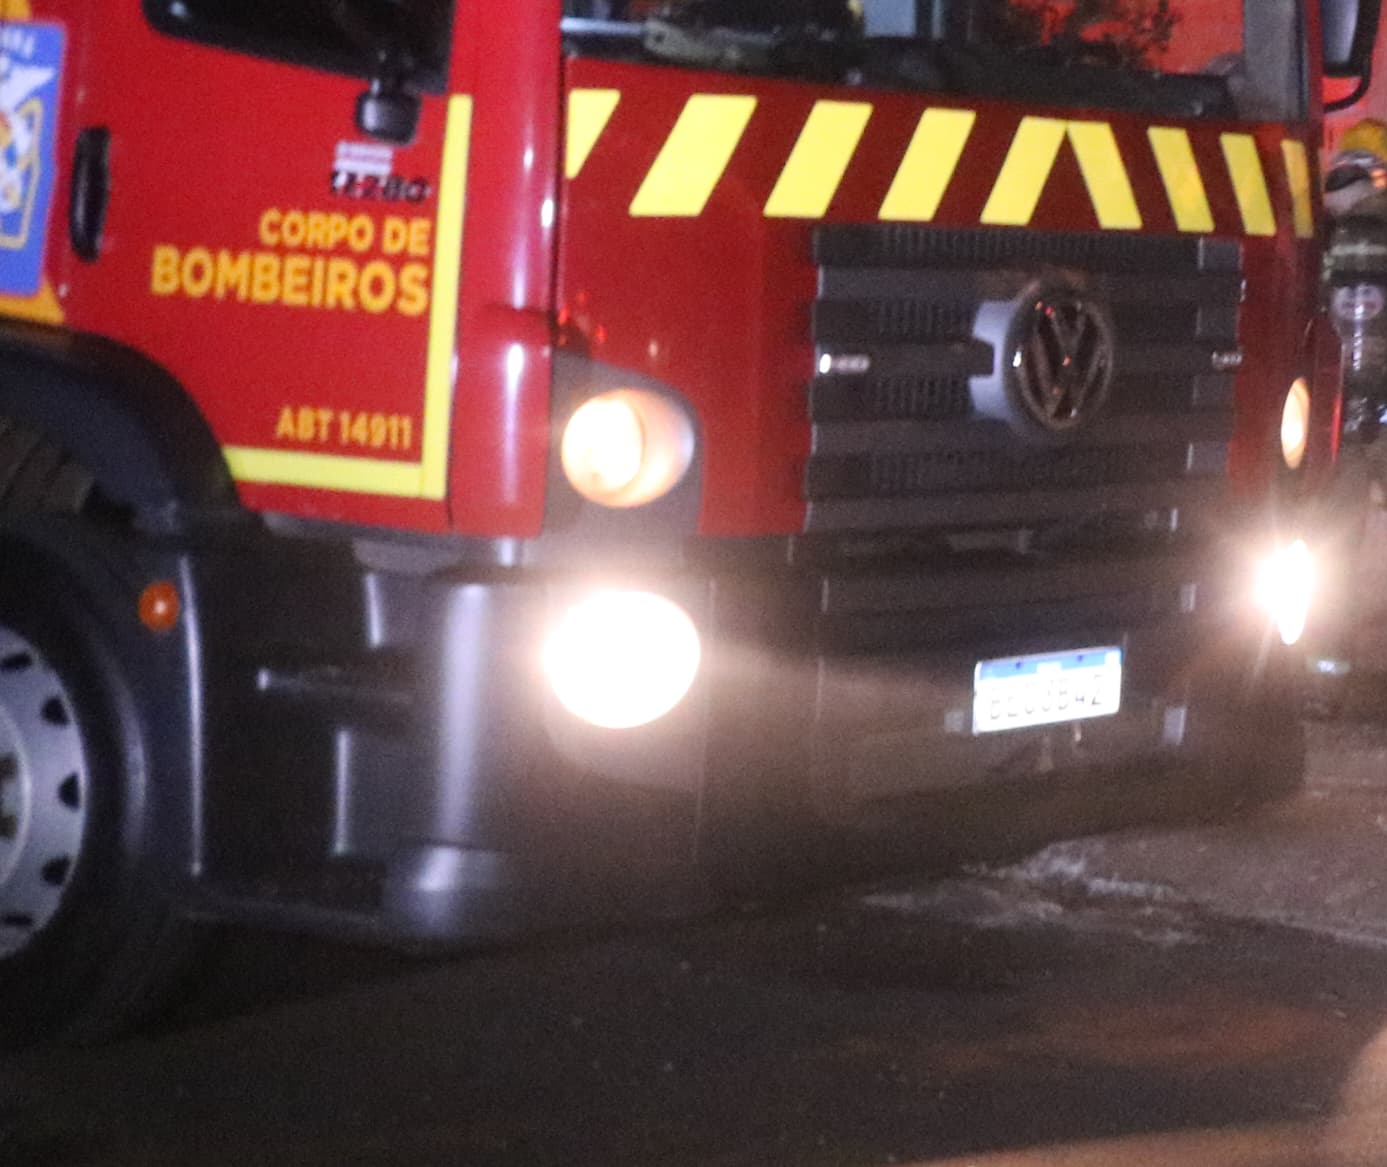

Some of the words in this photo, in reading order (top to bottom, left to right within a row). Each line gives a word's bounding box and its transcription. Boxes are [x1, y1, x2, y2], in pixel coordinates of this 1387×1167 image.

[259, 208, 374, 252] CORPO
[383, 216, 431, 256] DE
[150, 244, 429, 316] BOMBEIROS
[276, 404, 333, 441] ABT
[341, 411, 412, 449] 14911
